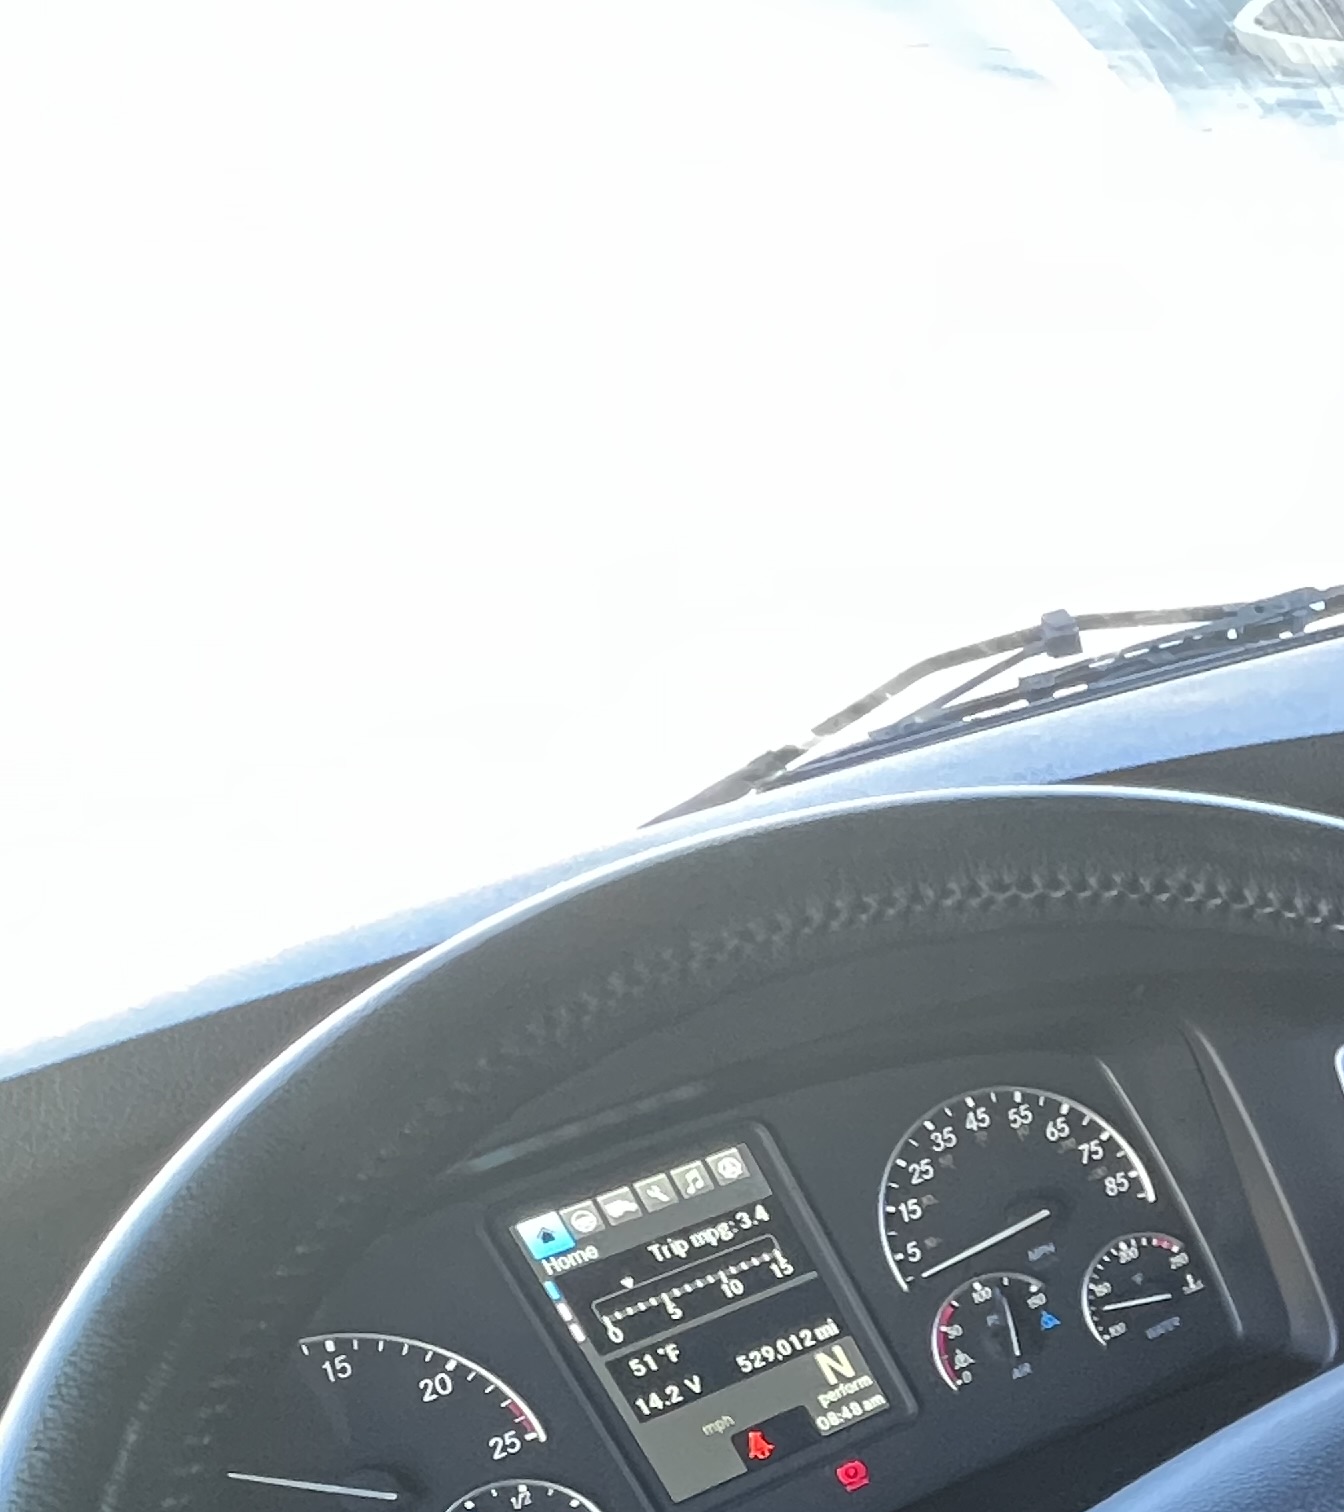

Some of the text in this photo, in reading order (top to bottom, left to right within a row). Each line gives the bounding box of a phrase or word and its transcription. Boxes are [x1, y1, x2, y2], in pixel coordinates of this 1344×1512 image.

[965, 1106, 991, 1132] 45
[1007, 1103, 1033, 1130] 55
[1045, 1116, 1070, 1142] 65
[930, 1126, 957, 1152] 35
[1078, 1139, 1104, 1165] 75
[908, 1158, 935, 1186] 25
[1104, 1172, 1130, 1197] 85
[899, 1198, 922, 1223] 15
[647, 1204, 770, 1262] Trip mpg: 3.4
[542, 1244, 600, 1276] Home
[906, 1240, 922, 1263] 5
[720, 1278, 744, 1298] 10
[768, 1258, 795, 1279] 15
[735, 1317, 841, 1374] 529,012 mi
[322, 1354, 352, 1382] 15
[628, 1353, 659, 1377] 51
[813, 1344, 857, 1386] N
[418, 1372, 453, 1403] 20
[634, 1375, 703, 1416] 14.2 V
[816, 1374, 874, 1409] perform
[701, 1414, 736, 1437] mph
[815, 1393, 887, 1432] 08:48 am
[488, 1430, 522, 1460] 25
